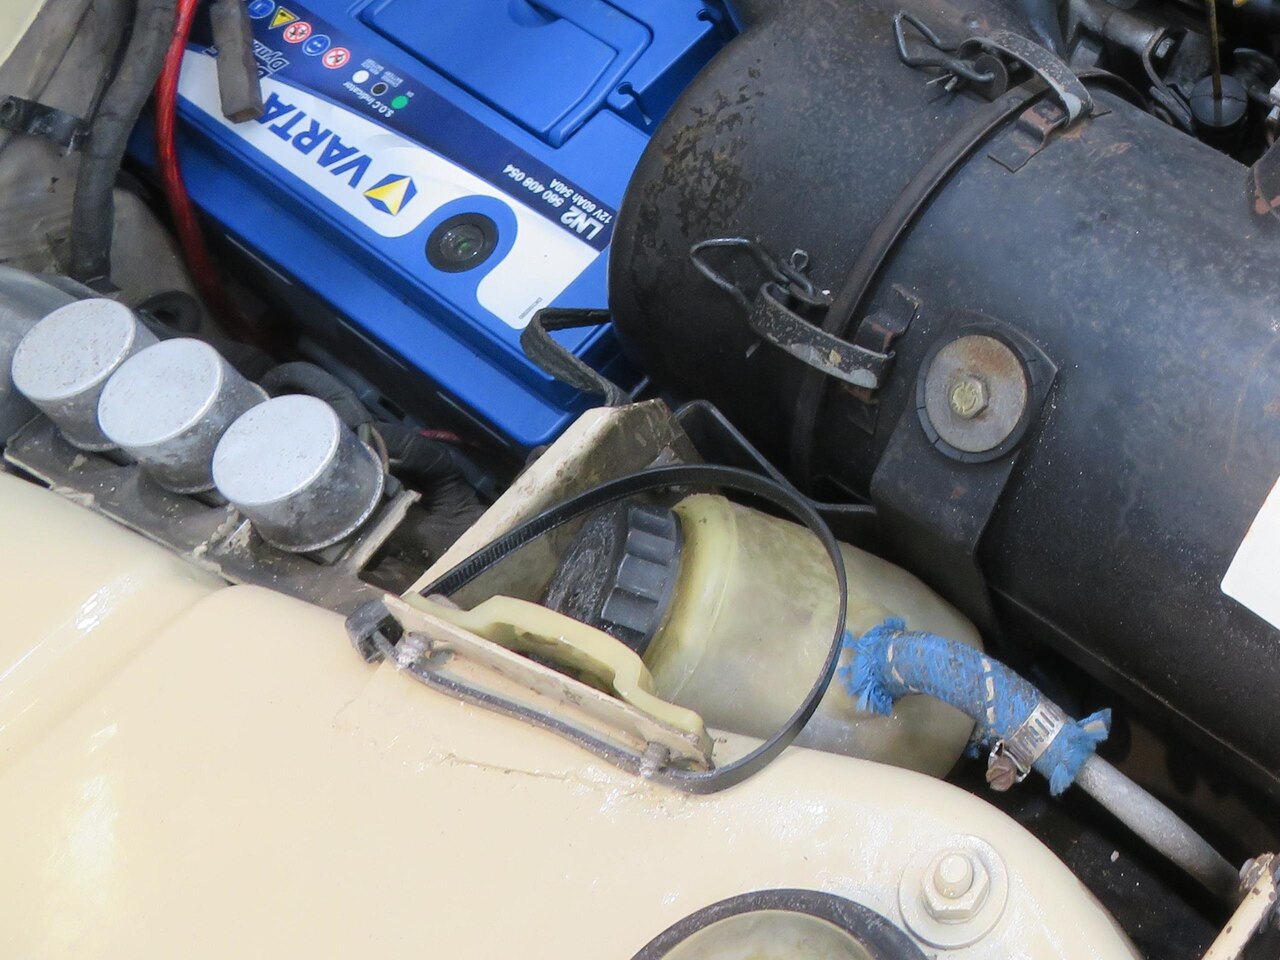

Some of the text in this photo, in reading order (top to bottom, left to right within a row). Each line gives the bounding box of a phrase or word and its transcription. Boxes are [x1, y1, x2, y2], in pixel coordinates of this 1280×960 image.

[343, 81, 377, 105] Indicator
[256, 91, 373, 189] VARTA
[502, 163, 605, 240] LN2 560 408 054
[549, 178, 613, 224] 12V 60Ah 540A
